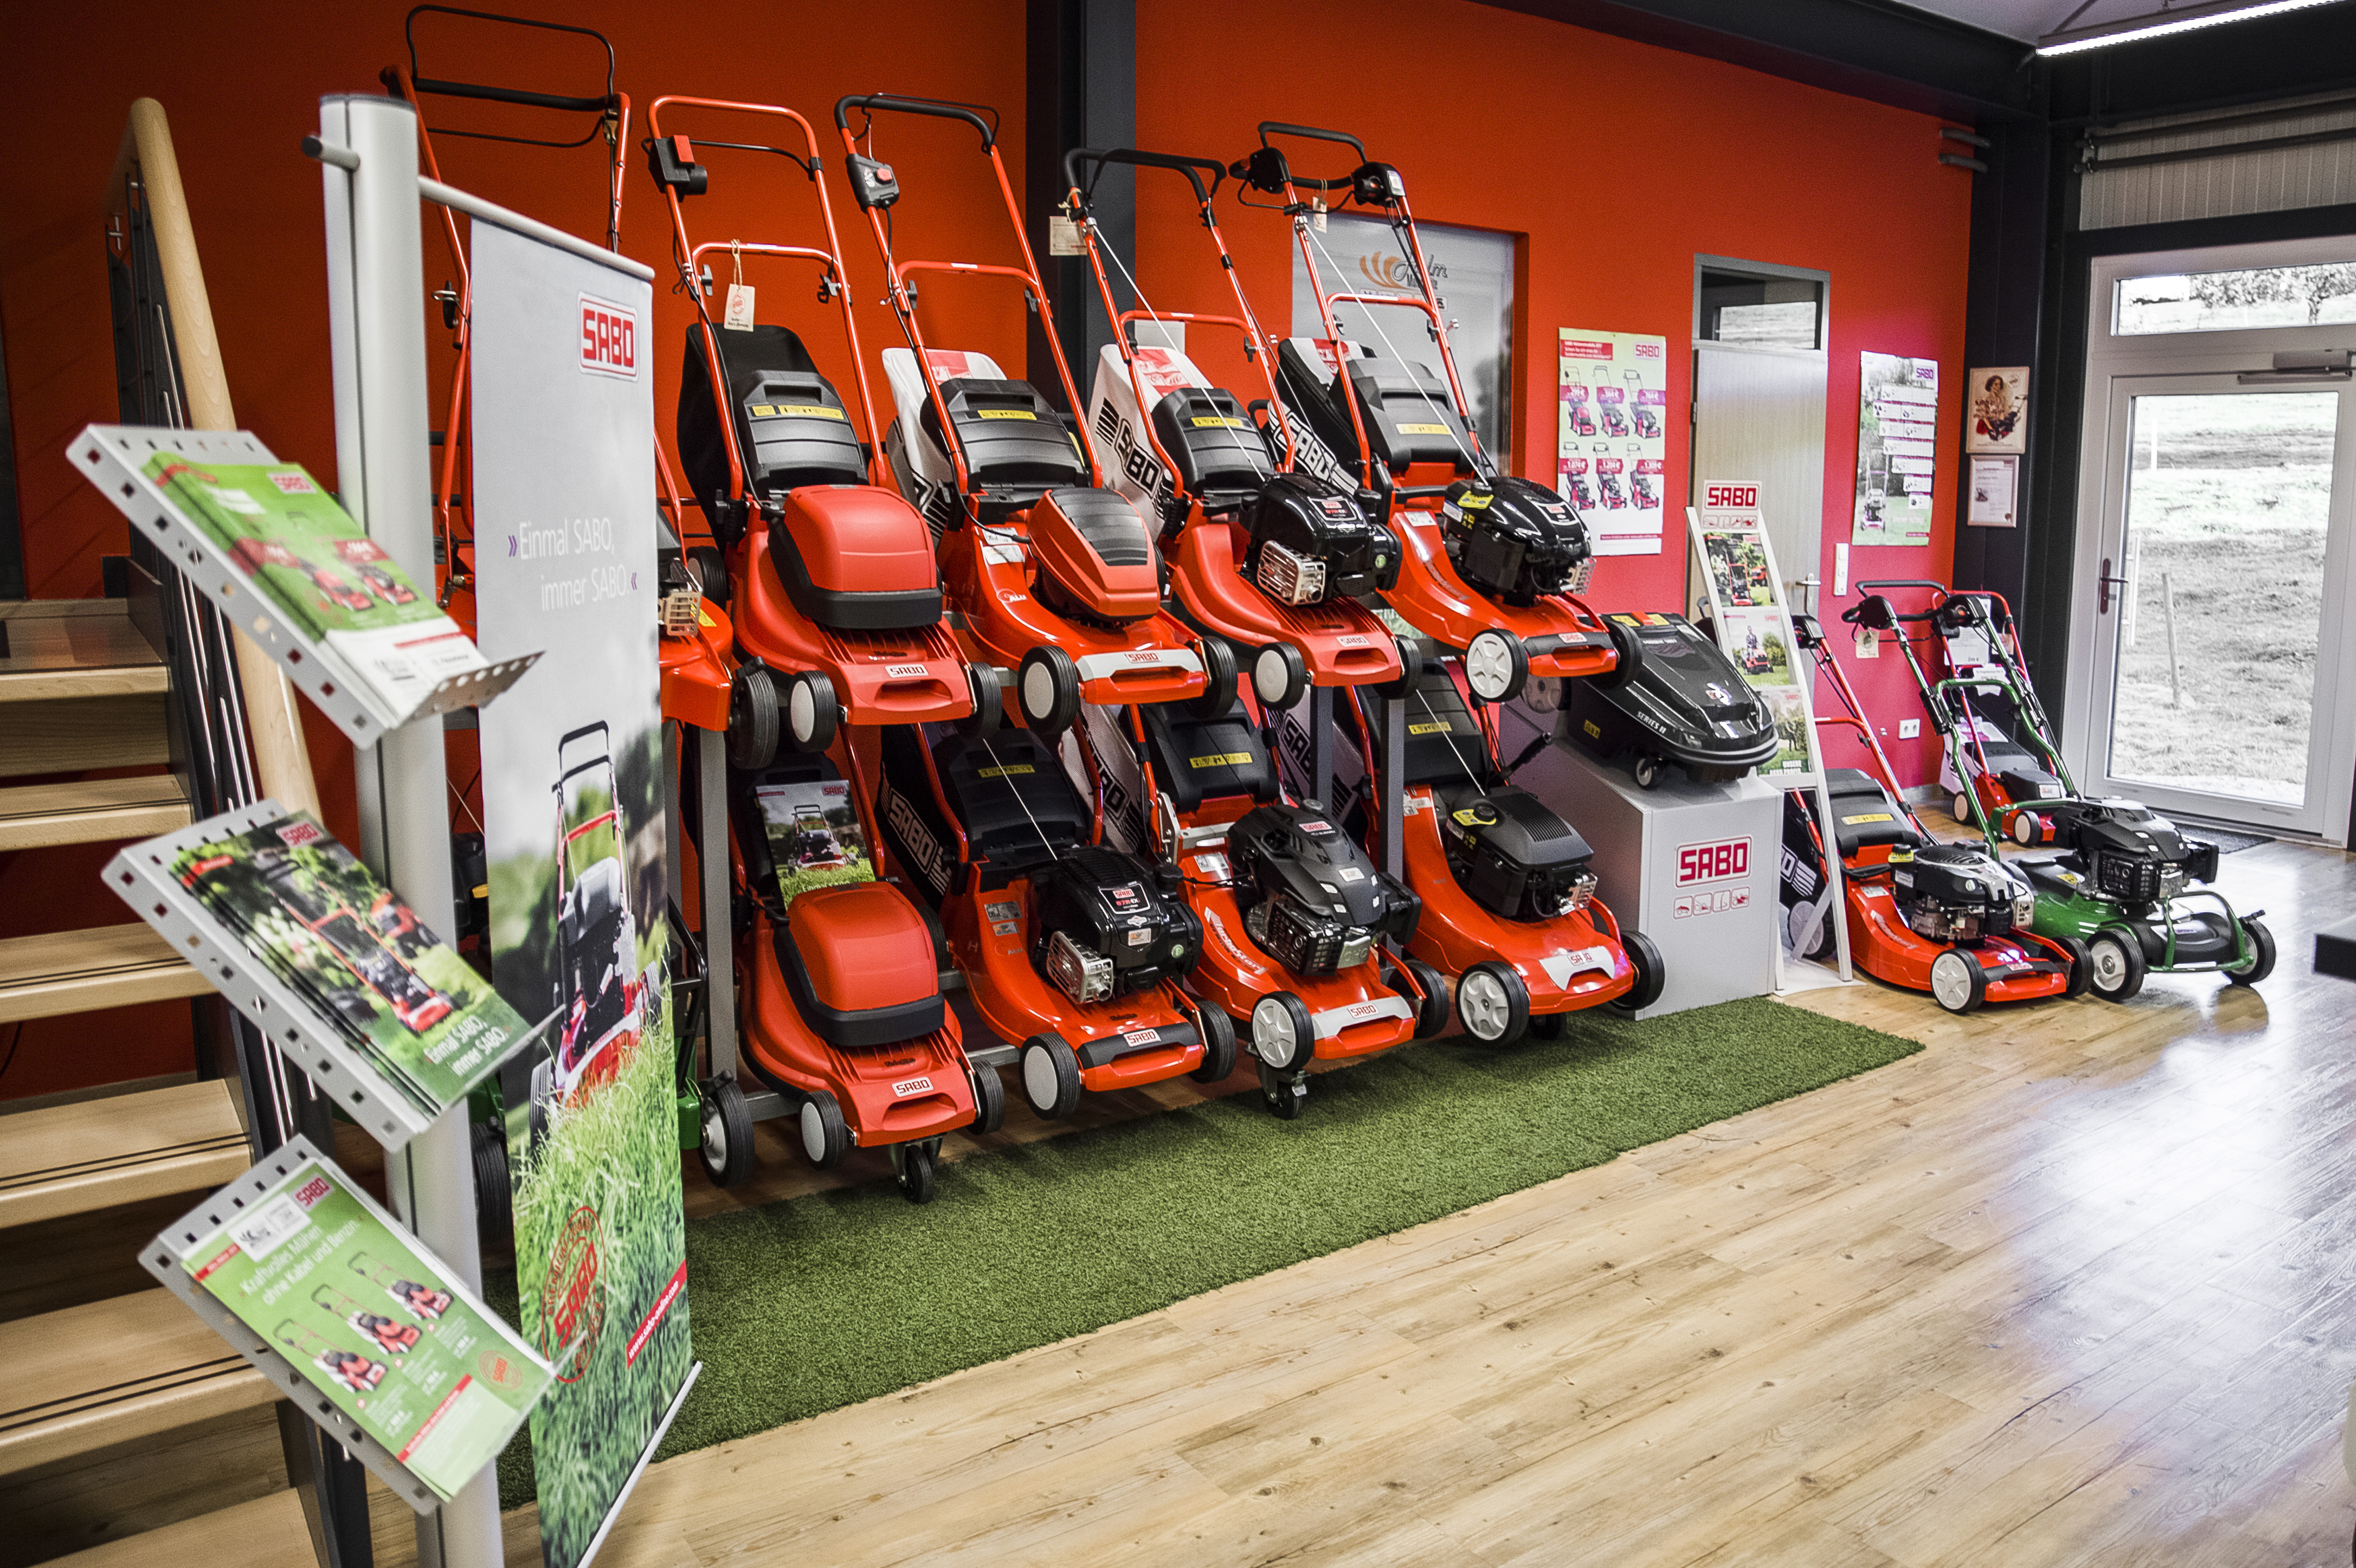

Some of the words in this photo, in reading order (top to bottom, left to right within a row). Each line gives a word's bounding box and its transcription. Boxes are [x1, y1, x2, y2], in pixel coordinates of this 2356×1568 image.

[583, 309, 634, 368] SABO
[1636, 345, 1659, 357] SABO
[1916, 368, 1933, 379] SABO
[1707, 487, 1756, 506] SABO
[574, 517, 614, 555] SABO,
[541, 574, 587, 612] immer
[1128, 653, 1158, 661] SABO
[890, 666, 925, 675] SABO
[1636, 711, 1659, 730] SERIES
[283, 823, 318, 846] SABO
[889, 795, 935, 867] SABO
[1680, 842, 1747, 882] SABO
[1571, 953, 1592, 963] SAO
[1350, 1005, 1376, 1016] SABO
[1127, 1031, 1156, 1044] SABO
[896, 1079, 930, 1094] SABO
[295, 1177, 330, 1207] SABO
[554, 1240, 598, 1350] SABO
[628, 1280, 679, 1359] www.sabo-online.com
